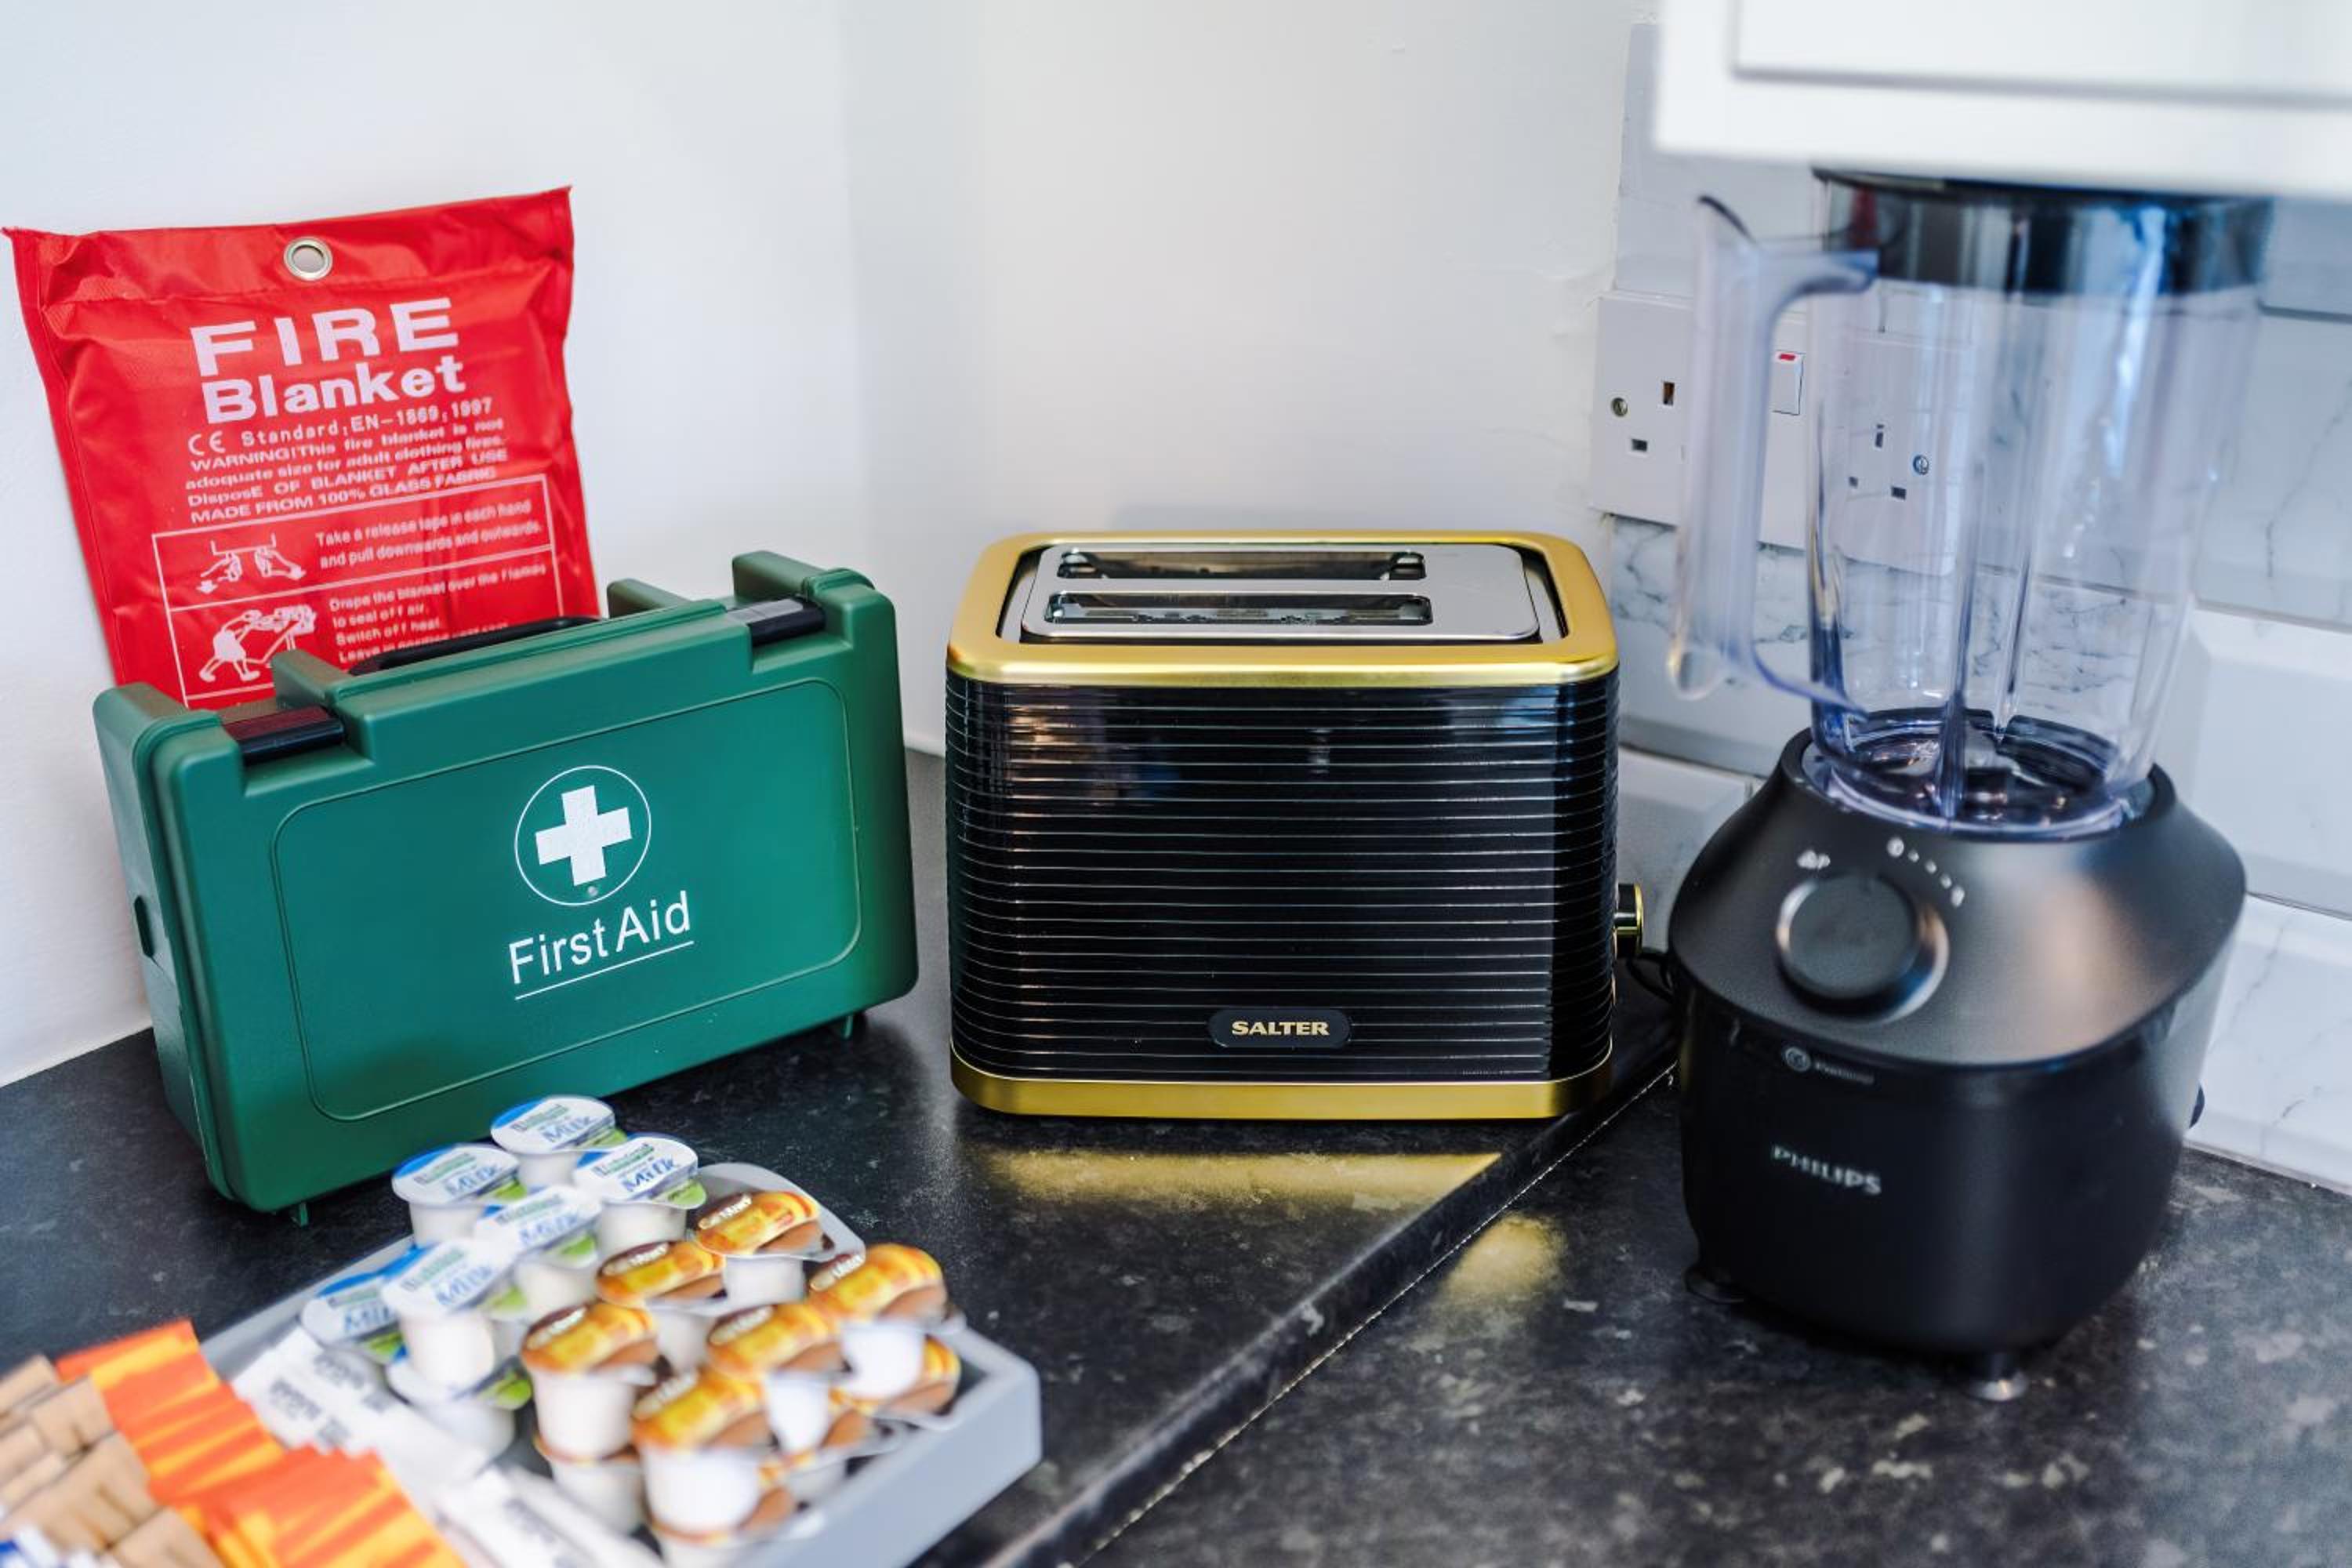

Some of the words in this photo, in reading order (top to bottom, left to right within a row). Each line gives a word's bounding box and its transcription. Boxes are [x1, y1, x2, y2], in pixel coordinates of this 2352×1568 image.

[190, 297, 459, 377] FIRE
[201, 354, 466, 424] Blanket
[345, 438, 372, 452] fire
[381, 426, 445, 445] blanket
[452, 423, 466, 436] is
[474, 418, 503, 432] not
[274, 480, 300, 495] OF
[310, 466, 397, 489] BLANKET
[408, 456, 463, 475] AFTER
[471, 448, 507, 465] USE
[317, 458, 340, 473] for
[347, 451, 390, 468] adult
[394, 441, 463, 460] clothing
[191, 504, 251, 524] MADE
[255, 495, 313, 515] FROM
[318, 488, 366, 505] 100%
[369, 477, 431, 496] GLASS
[316, 530, 351, 547] Take
[354, 528, 363, 542] a
[365, 520, 417, 539] release
[497, 499, 532, 517] hand
[320, 552, 346, 569] and
[348, 547, 374, 565] pull
[376, 536, 452, 558] downwards
[455, 529, 478, 546] and
[329, 595, 371, 612] Drape
[373, 590, 395, 604] the
[397, 582, 445, 600] blanket
[448, 576, 476, 592] over
[332, 617, 347, 629] to
[349, 610, 378, 626] seal
[336, 628, 382, 646] Switch
[509, 918, 609, 984] First
[616, 891, 690, 953] Aid
[1232, 1020, 1330, 1036] SALTER
[1773, 1145, 1881, 1194] PHILIPS
